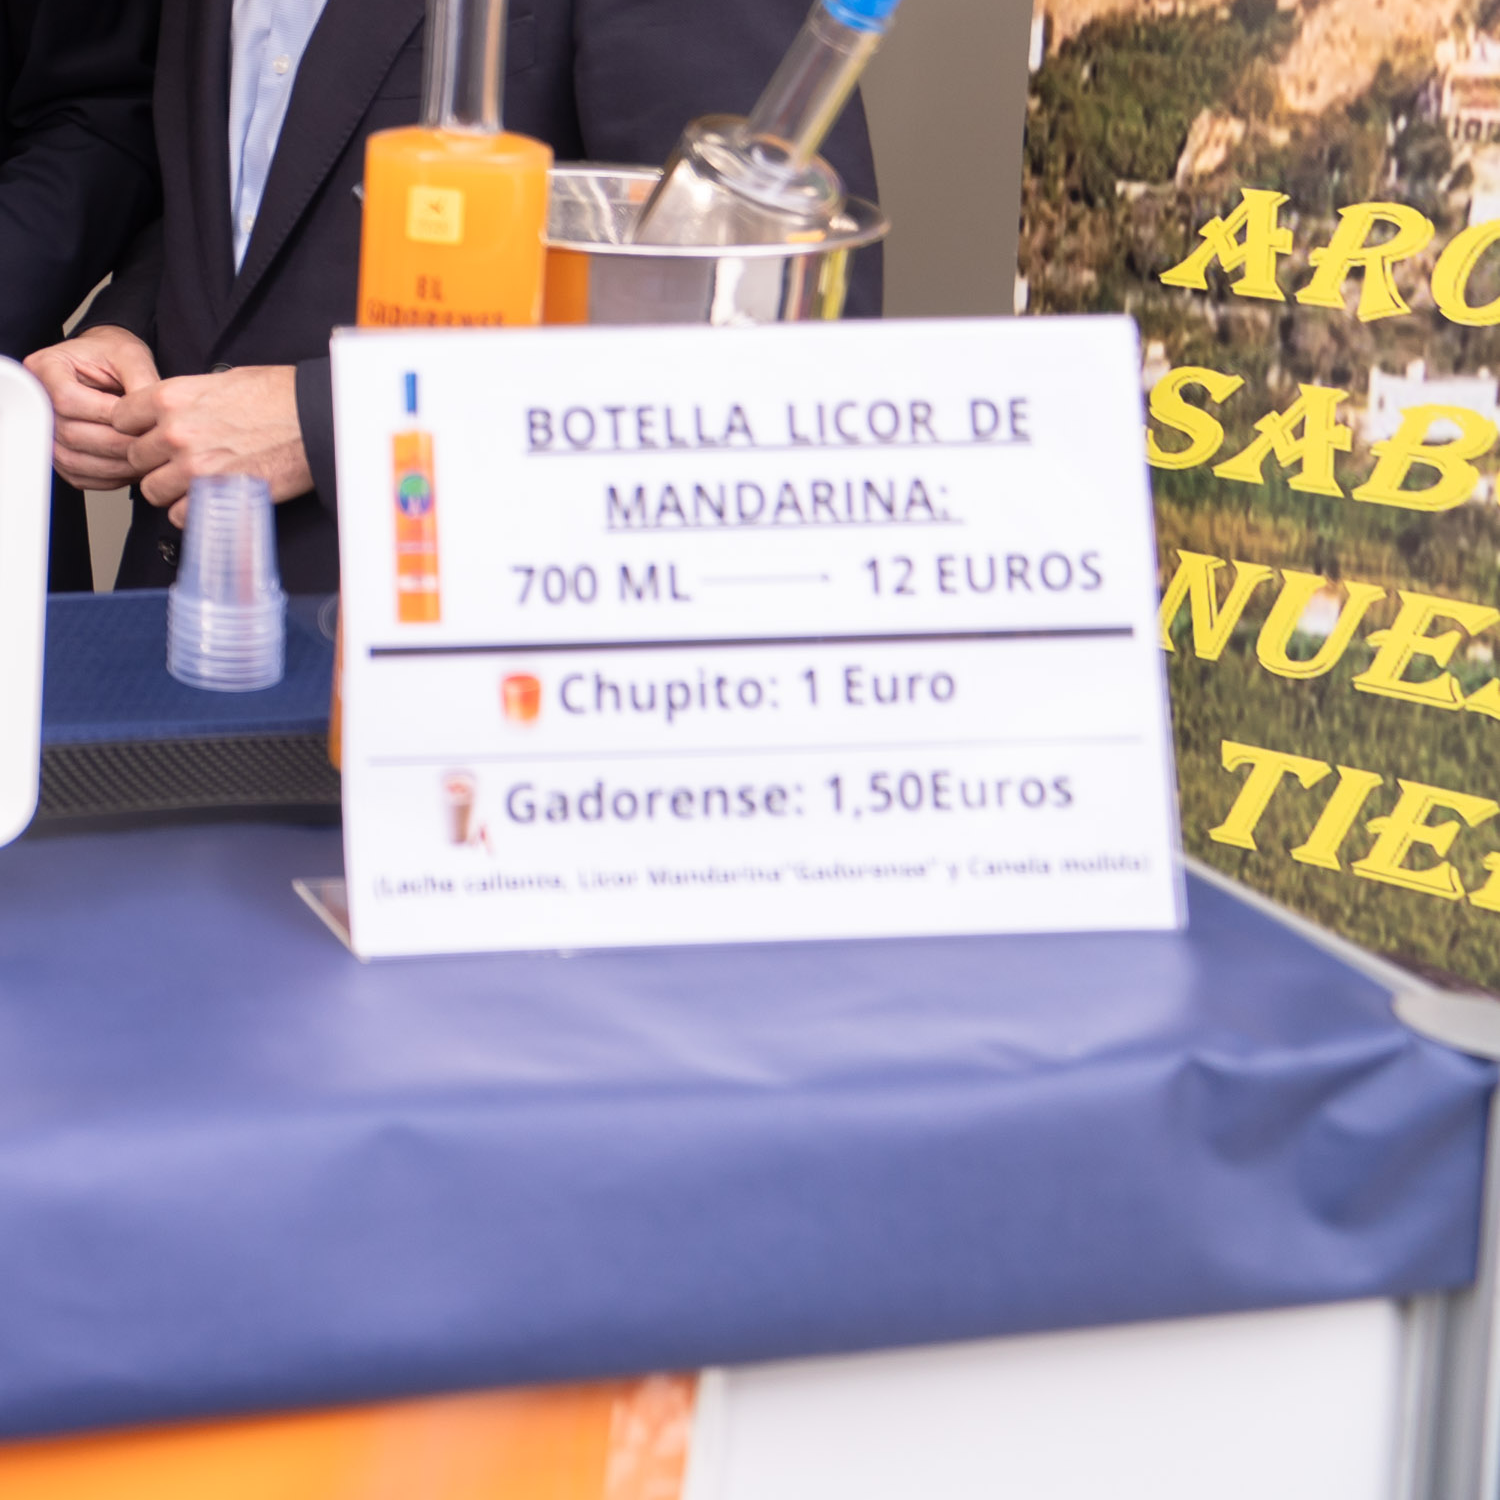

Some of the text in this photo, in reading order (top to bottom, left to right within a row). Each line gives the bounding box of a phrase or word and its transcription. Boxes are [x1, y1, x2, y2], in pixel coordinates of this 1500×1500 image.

[526, 397, 1031, 451] BOTELLA LICOR DE
[1144, 366, 1500, 511] SAB
[606, 477, 951, 528] MANDARINA:
[511, 550, 1104, 606] 700 ML 12 EUROS
[559, 665, 956, 725] Chupito: 1 Euro
[504, 769, 1075, 826] Gadorense: 1,50Euros
[1208, 740, 1500, 912] TIE
